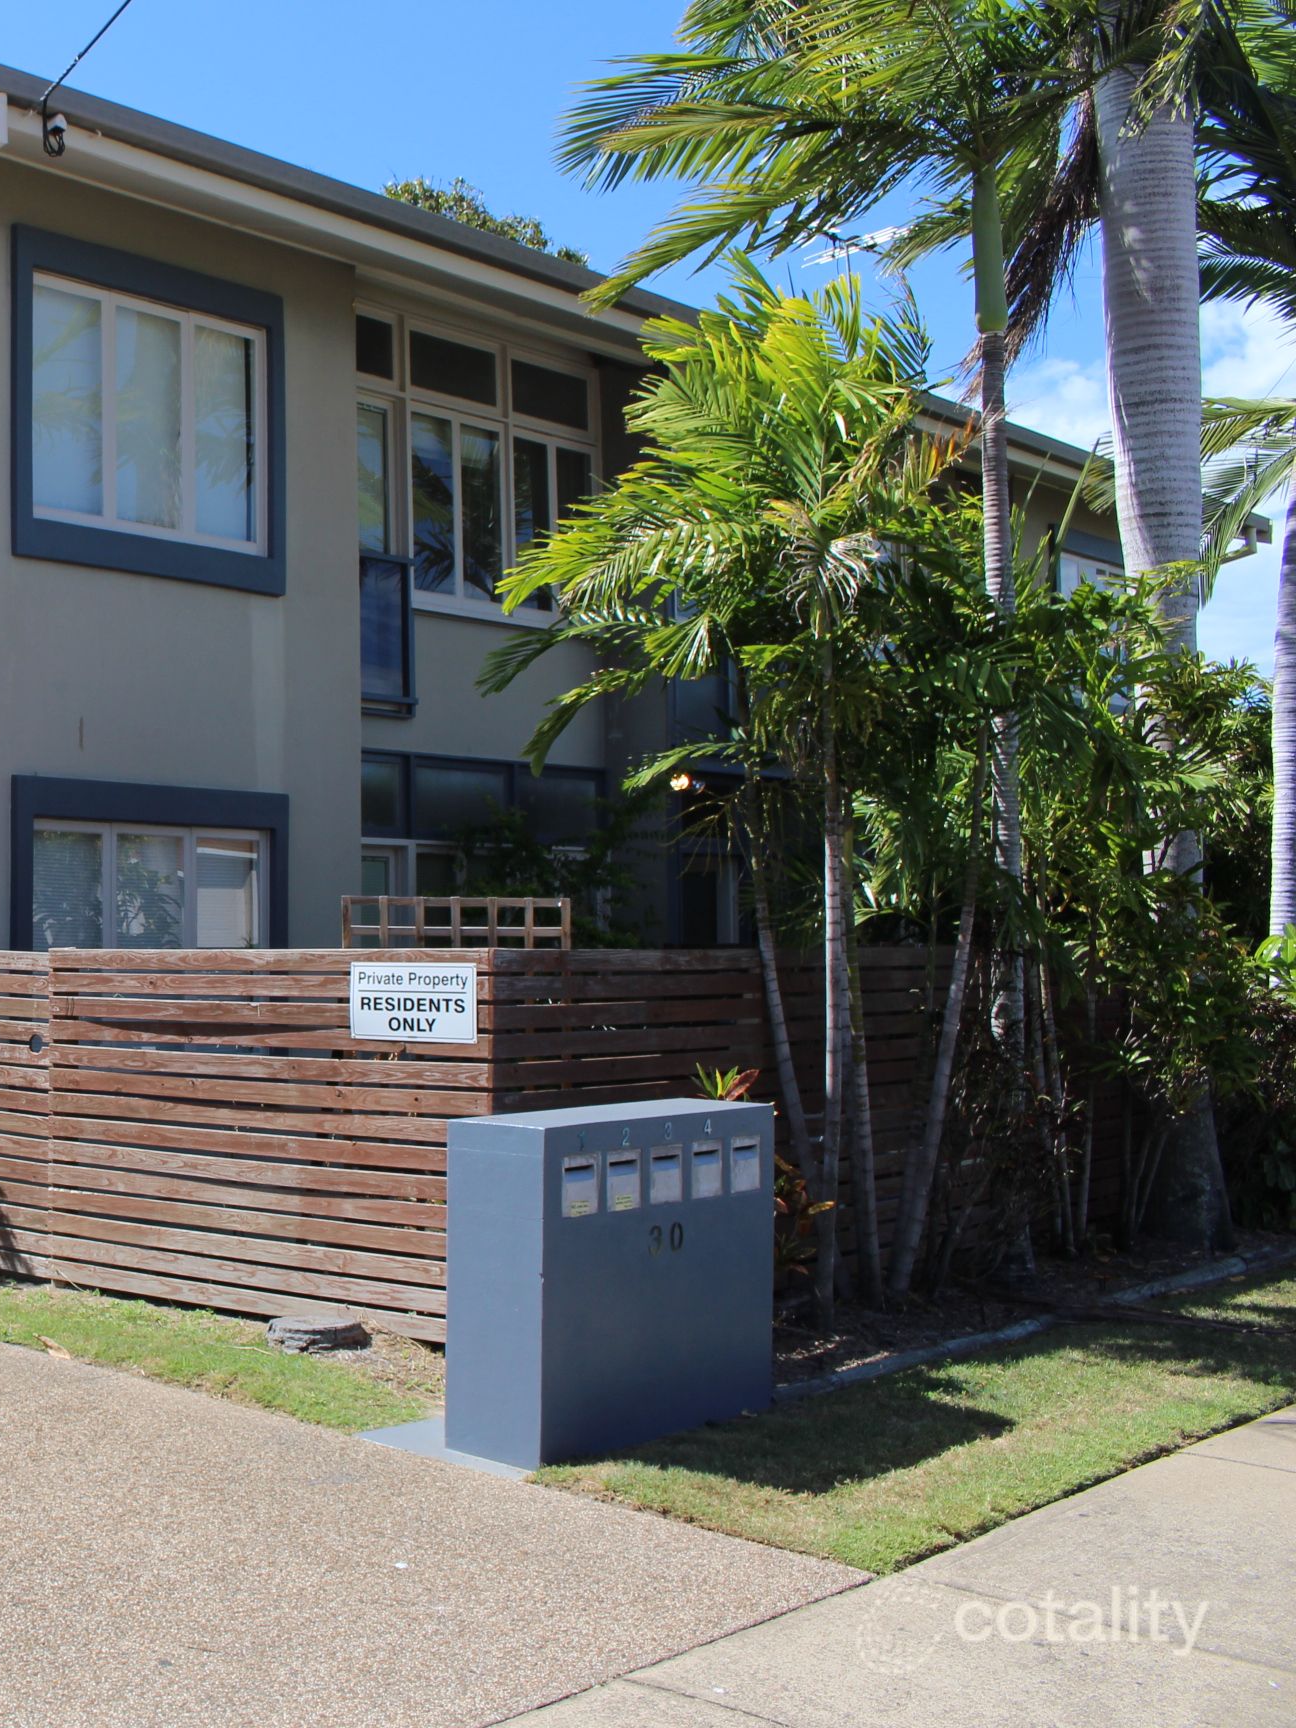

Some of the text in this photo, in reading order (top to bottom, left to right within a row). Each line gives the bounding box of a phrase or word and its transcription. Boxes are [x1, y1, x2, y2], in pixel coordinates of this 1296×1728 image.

[357, 971, 468, 990] Private Property
[360, 996, 466, 1014] RESIDENTS
[388, 1016, 437, 1033] ONLY
[664, 1121, 673, 1140] 3
[704, 1118, 713, 1135] 4
[622, 1127, 631, 1147] 2
[648, 1221, 684, 1256] 30
